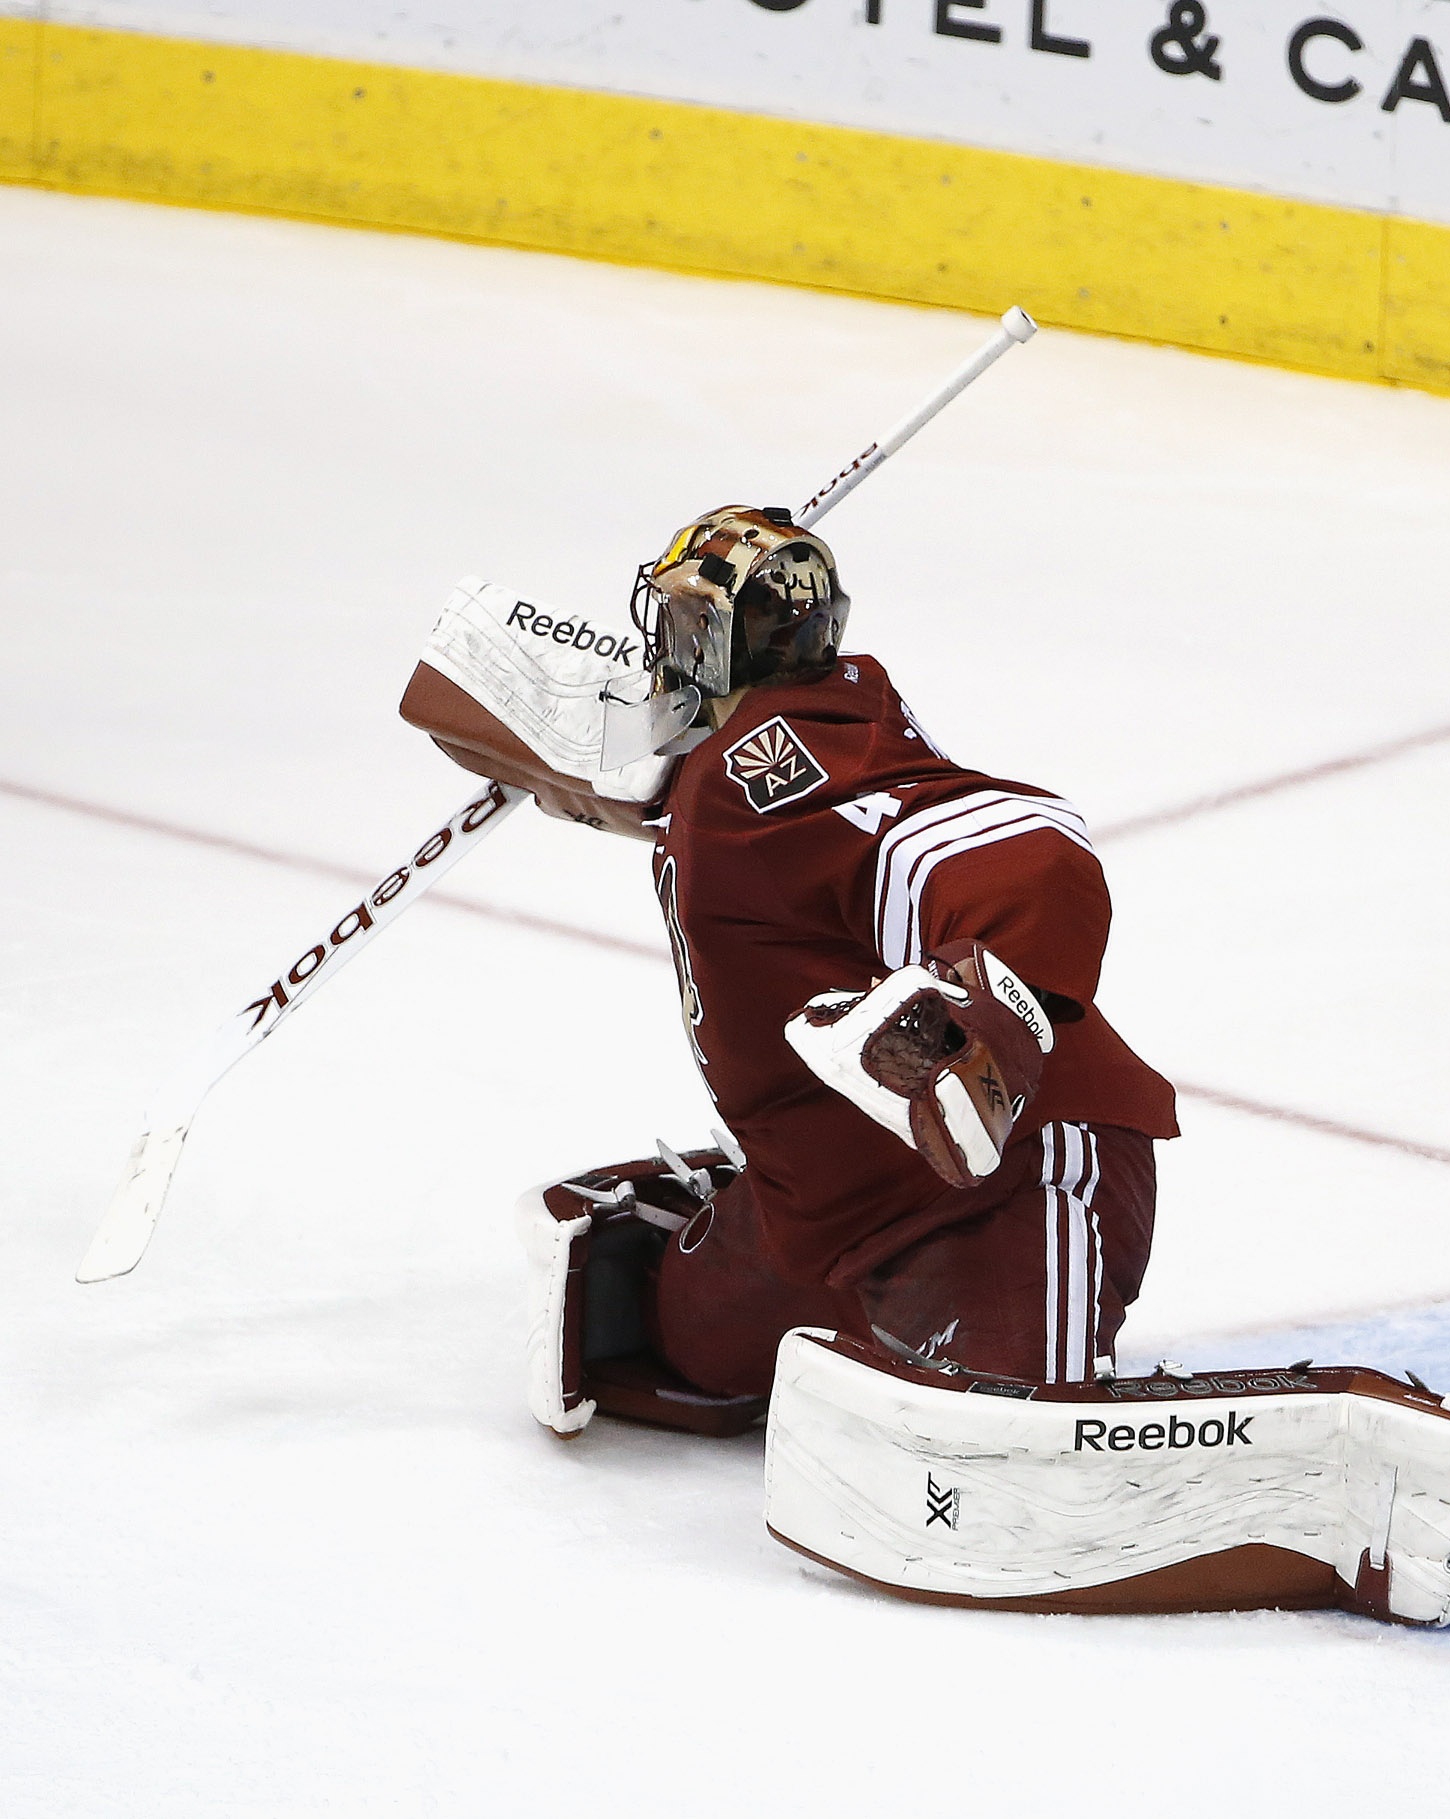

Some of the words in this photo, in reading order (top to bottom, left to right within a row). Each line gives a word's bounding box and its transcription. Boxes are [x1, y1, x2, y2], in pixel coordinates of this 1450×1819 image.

[1150, 0, 1222, 80] &
[506, 600, 638, 667] Reebok
[765, 754, 807, 797] AZ
[237, 778, 508, 1036] Reebok
[1105, 1374, 1317, 1399] Reebok
[1074, 1411, 1254, 1451] Reebok
